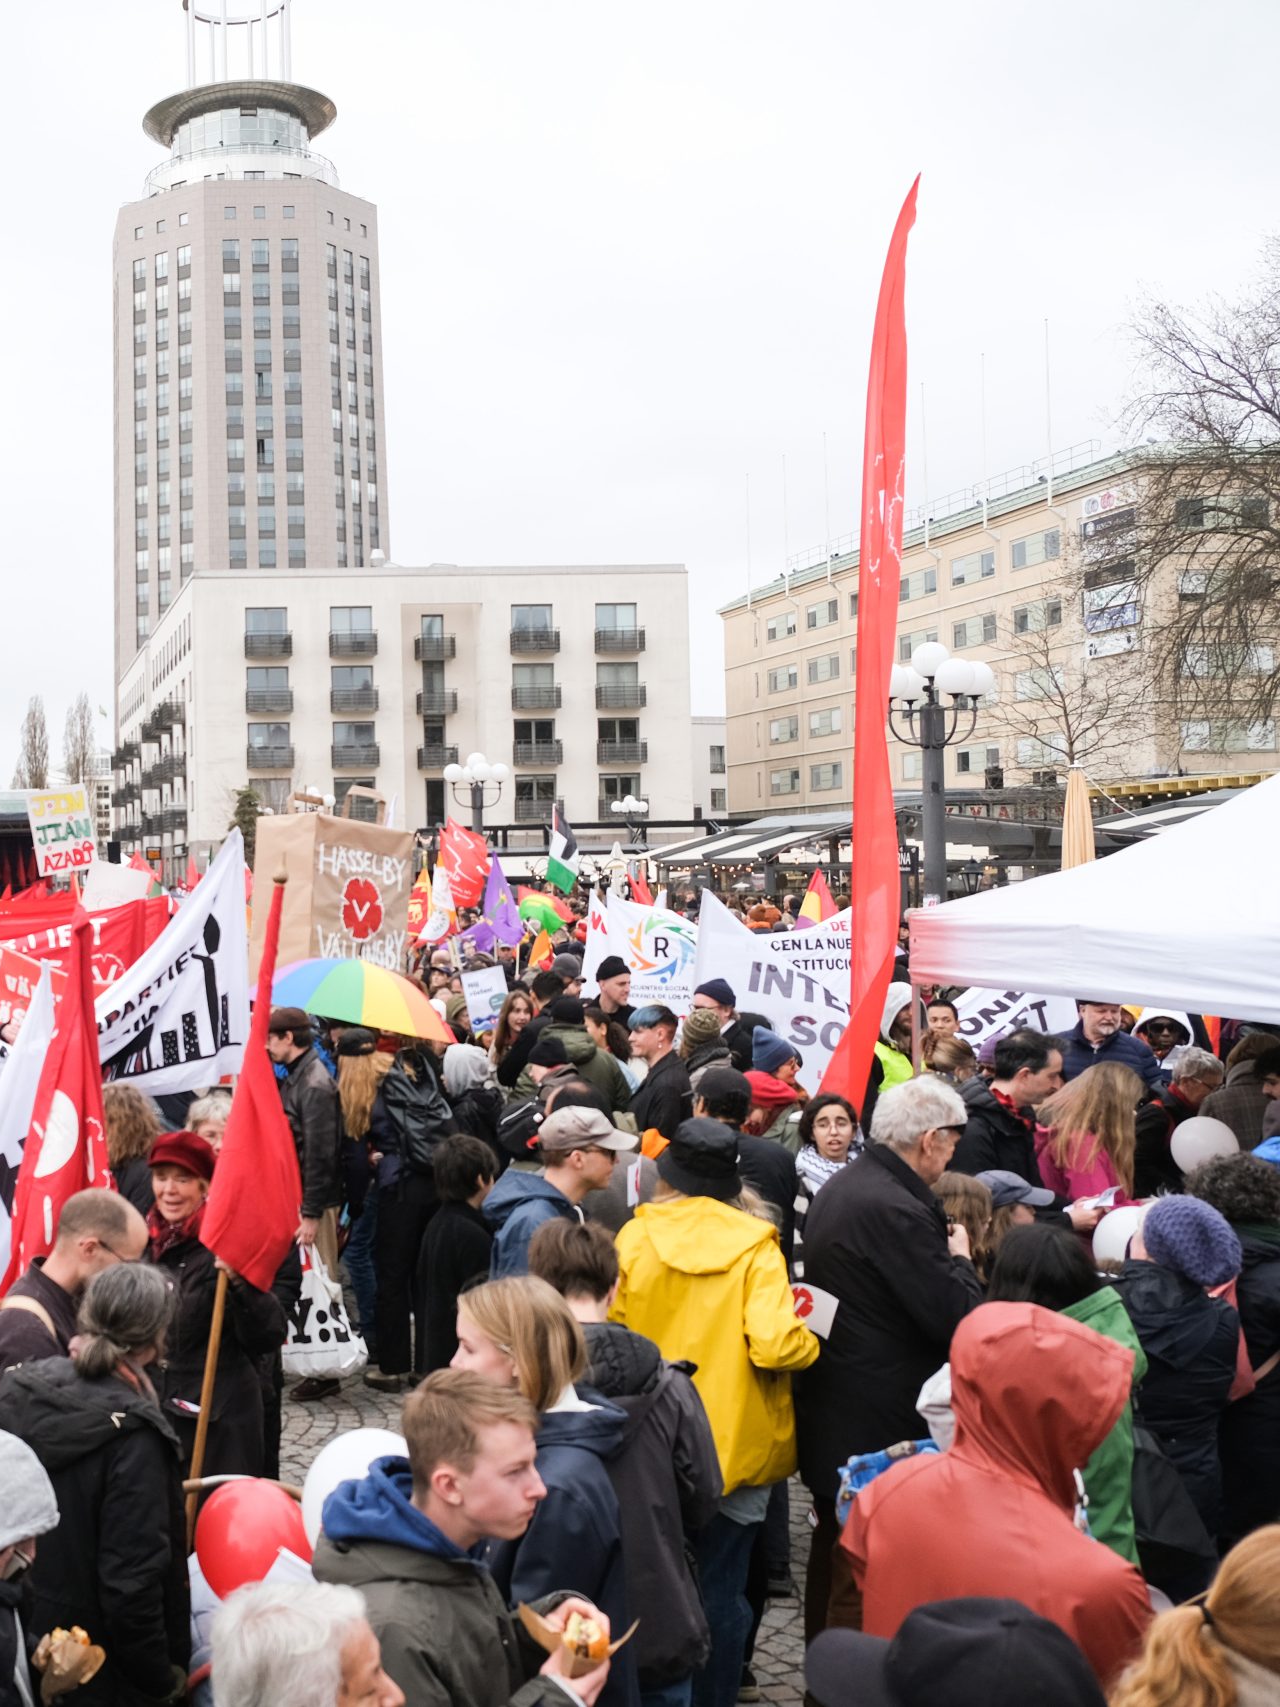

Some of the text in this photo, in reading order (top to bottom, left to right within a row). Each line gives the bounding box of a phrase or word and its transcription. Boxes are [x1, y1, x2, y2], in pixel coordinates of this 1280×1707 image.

[317, 843, 407, 891] HÄSSELBY
[654, 937, 669, 957] R
[805, 938, 824, 950] LA
